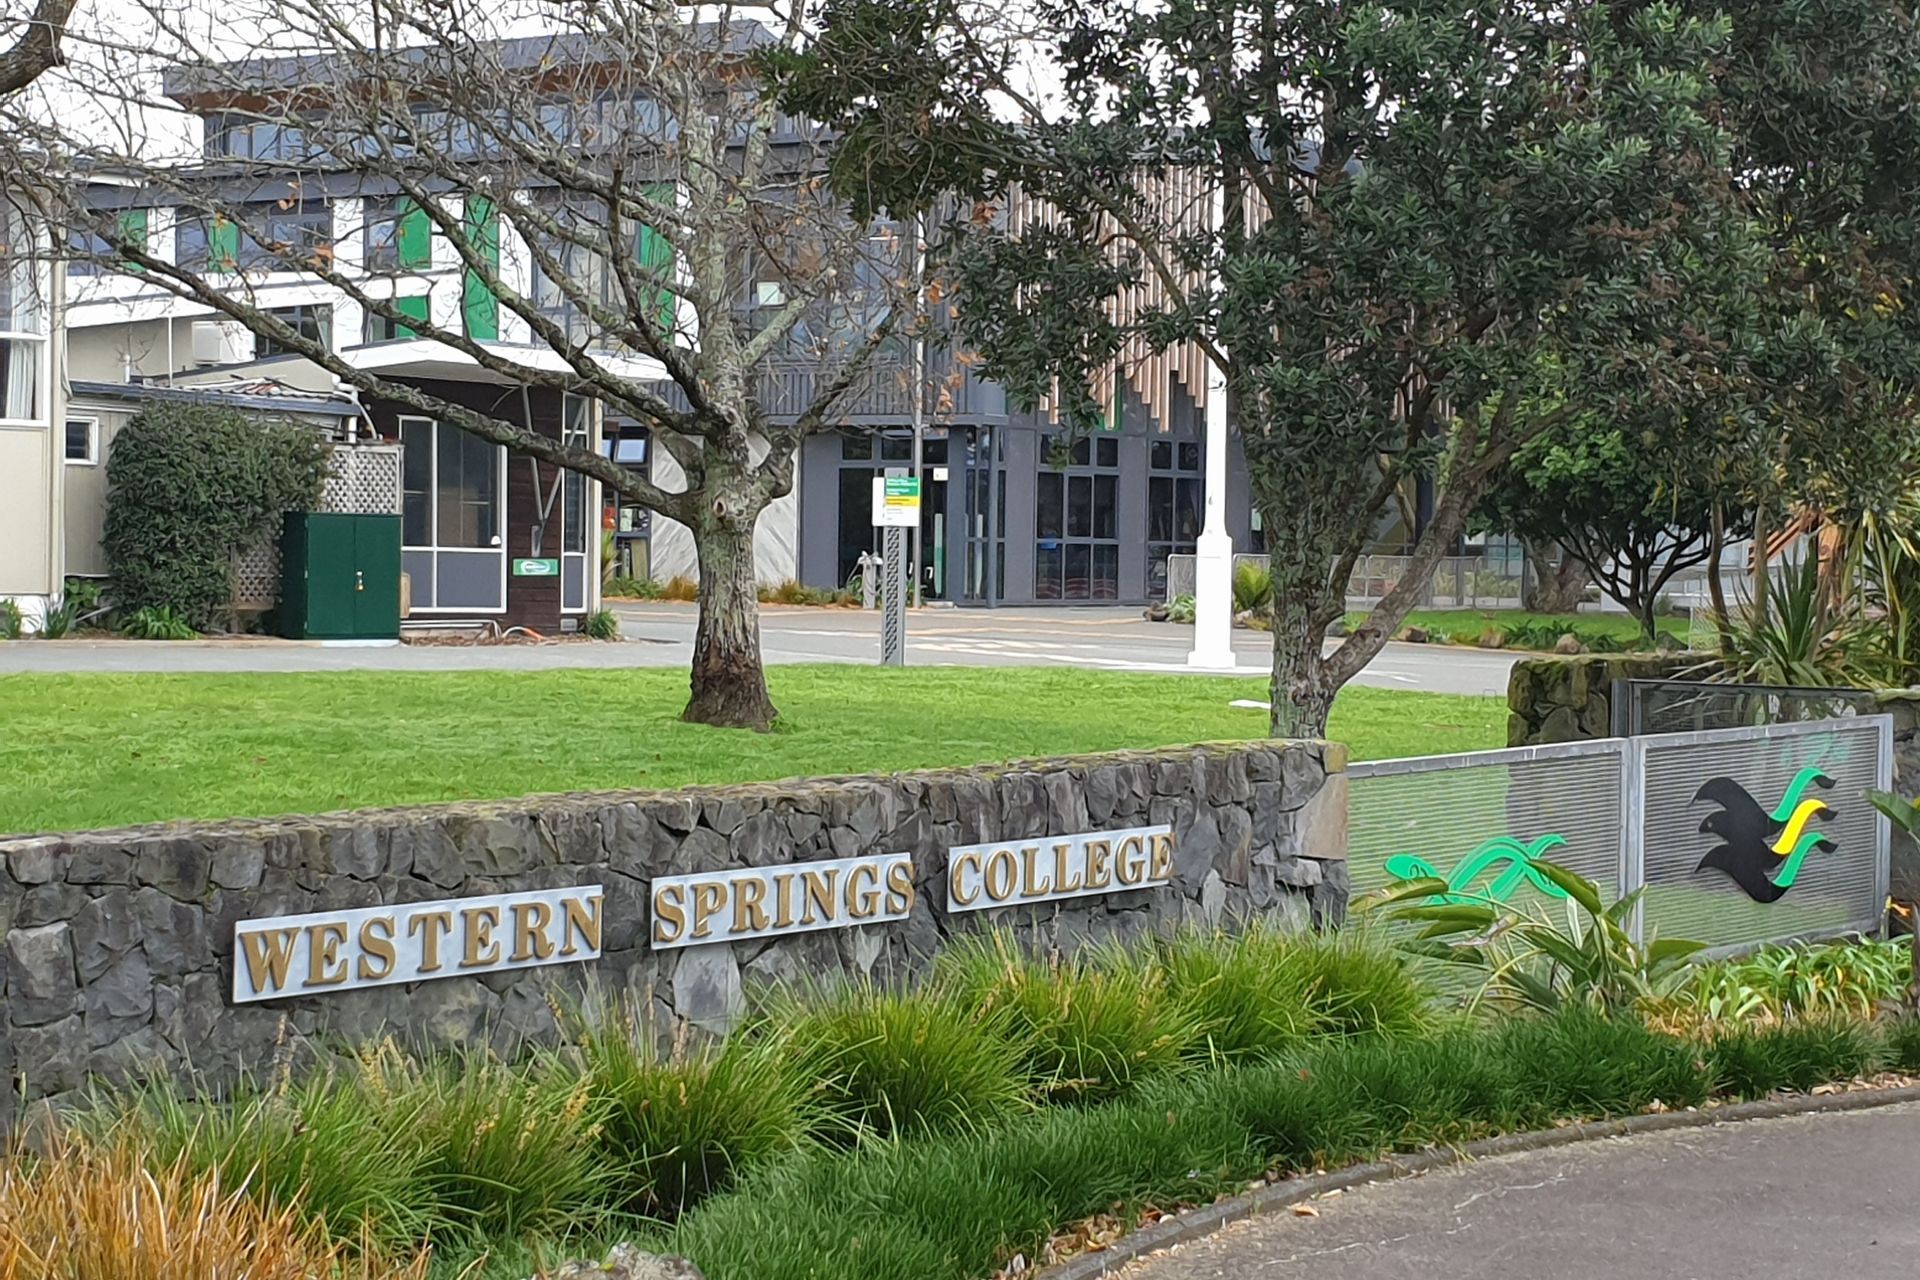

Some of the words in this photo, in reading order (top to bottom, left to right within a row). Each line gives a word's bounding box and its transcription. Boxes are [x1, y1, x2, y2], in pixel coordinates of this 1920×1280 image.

[239, 895, 603, 993] WESTERN
[653, 861, 915, 943] SPRINGS
[950, 834, 1174, 906] COLLEGE
